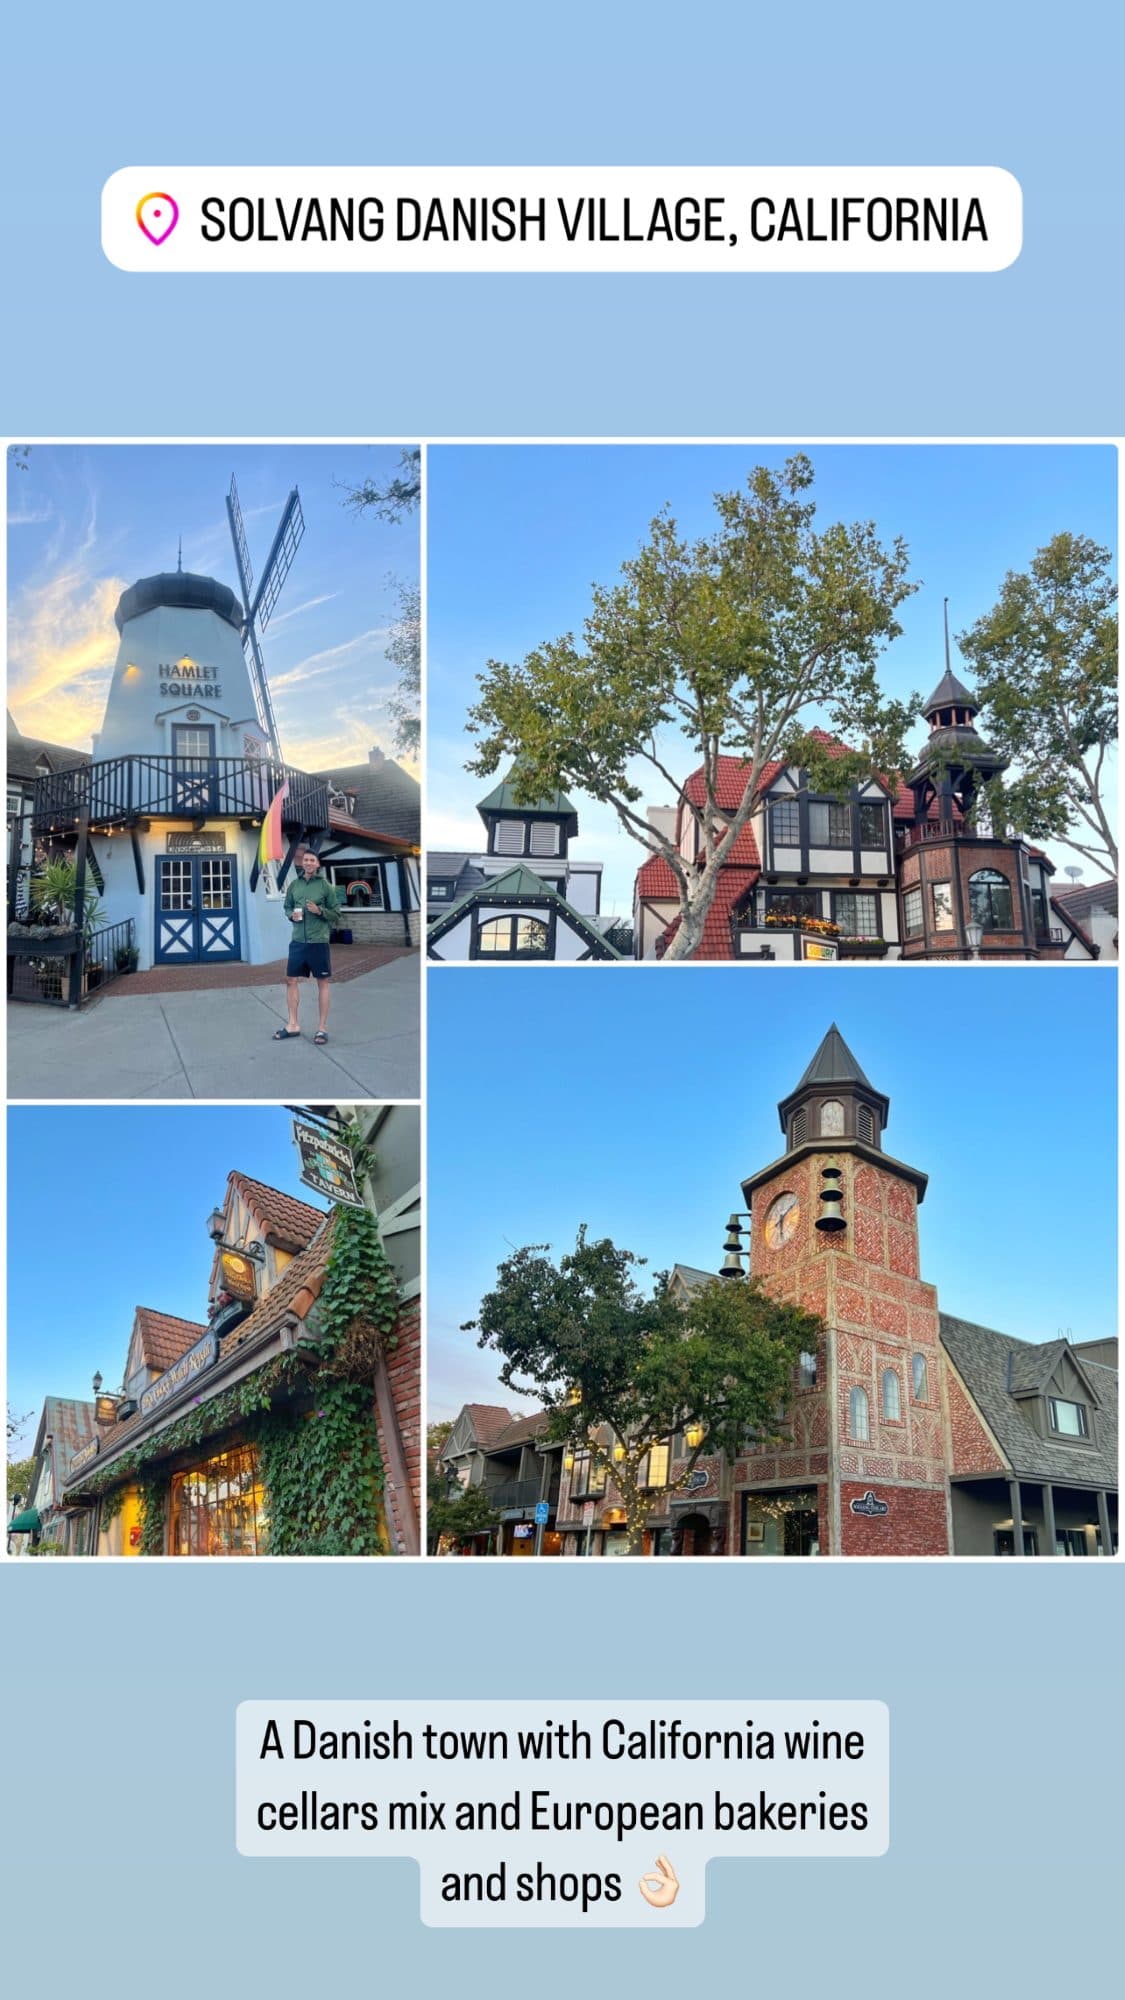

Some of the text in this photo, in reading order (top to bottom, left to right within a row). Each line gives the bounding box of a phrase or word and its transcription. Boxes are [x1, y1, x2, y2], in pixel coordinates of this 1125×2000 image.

[159, 664, 219, 679] HAMLET
[160, 683, 222, 697] SQUARE
[310, 1172, 356, 1202] TAVERN
